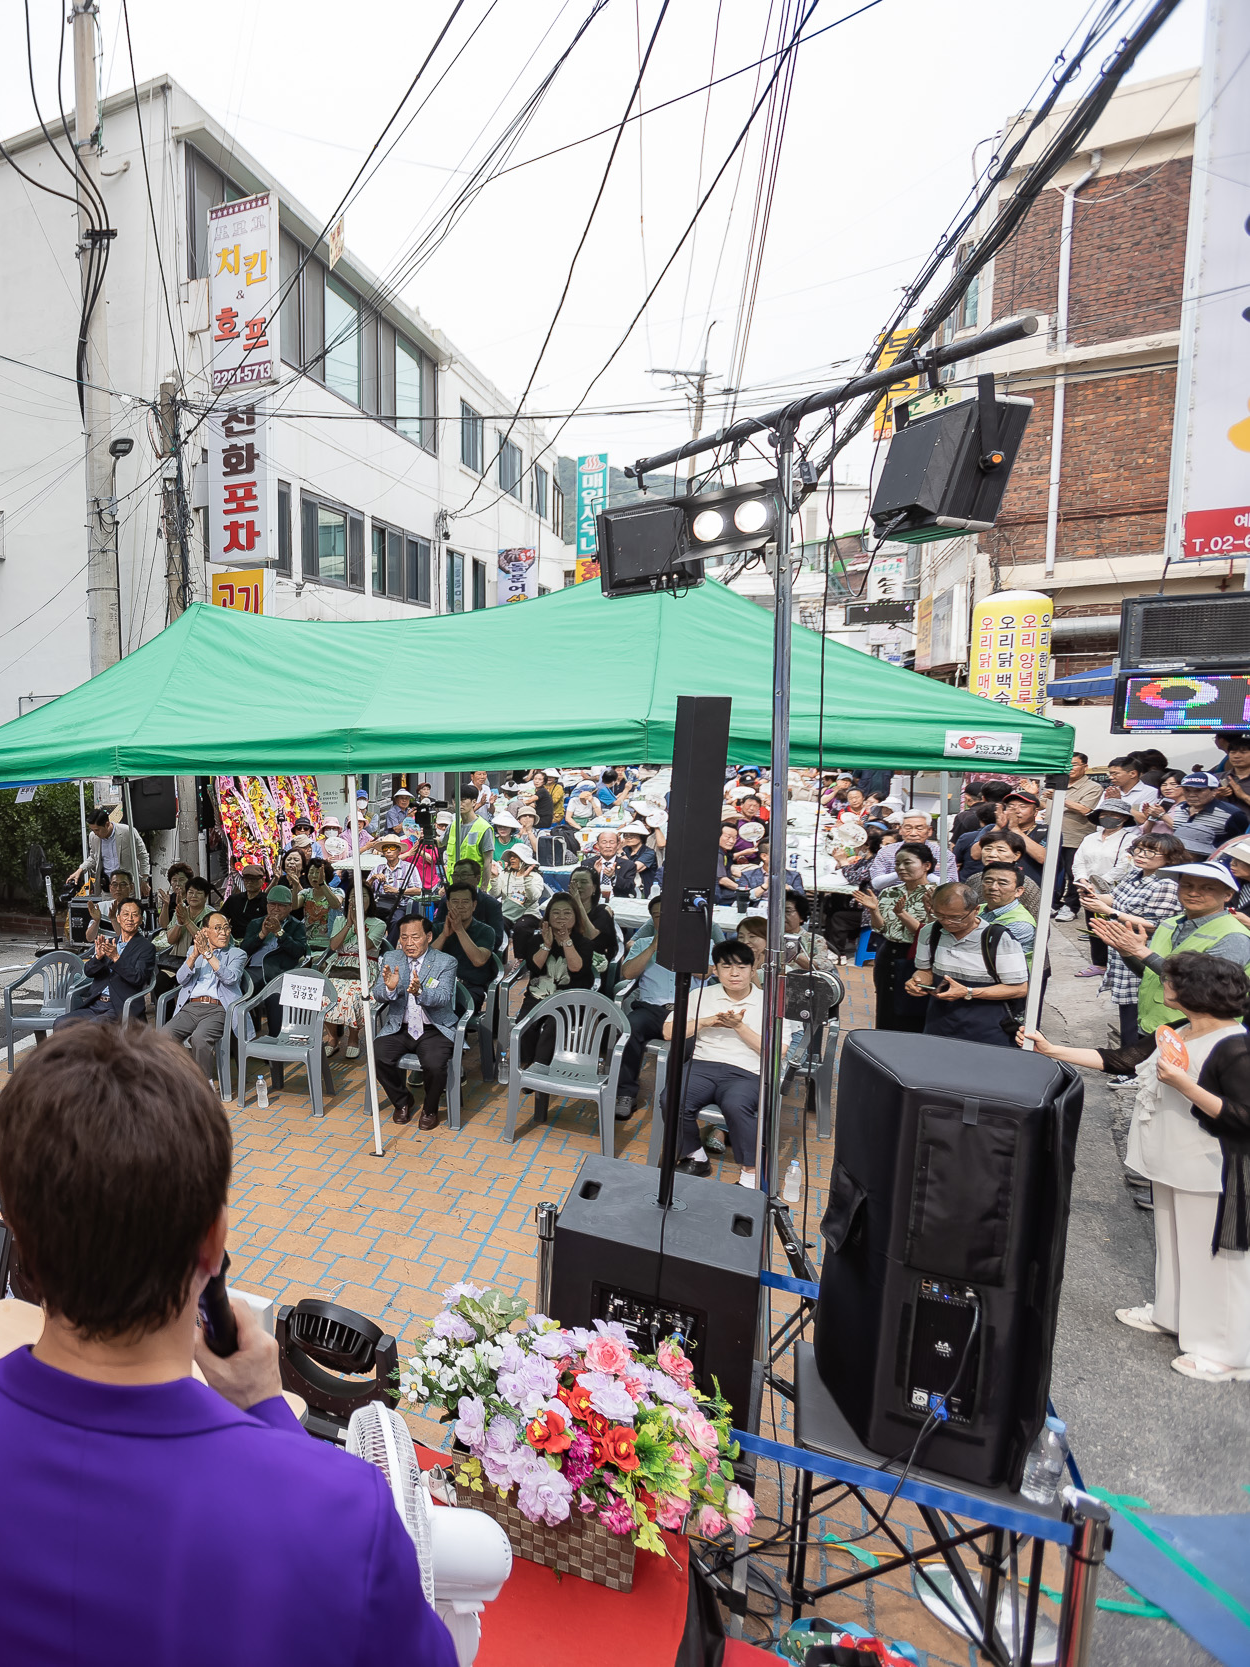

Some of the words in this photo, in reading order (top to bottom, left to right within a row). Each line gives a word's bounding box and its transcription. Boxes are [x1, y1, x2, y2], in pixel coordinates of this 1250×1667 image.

[214, 244, 268, 286] 치킨
[236, 290, 245, 300] &
[214, 306, 269, 351] 호프
[213, 365, 272, 388] 2201-5713
